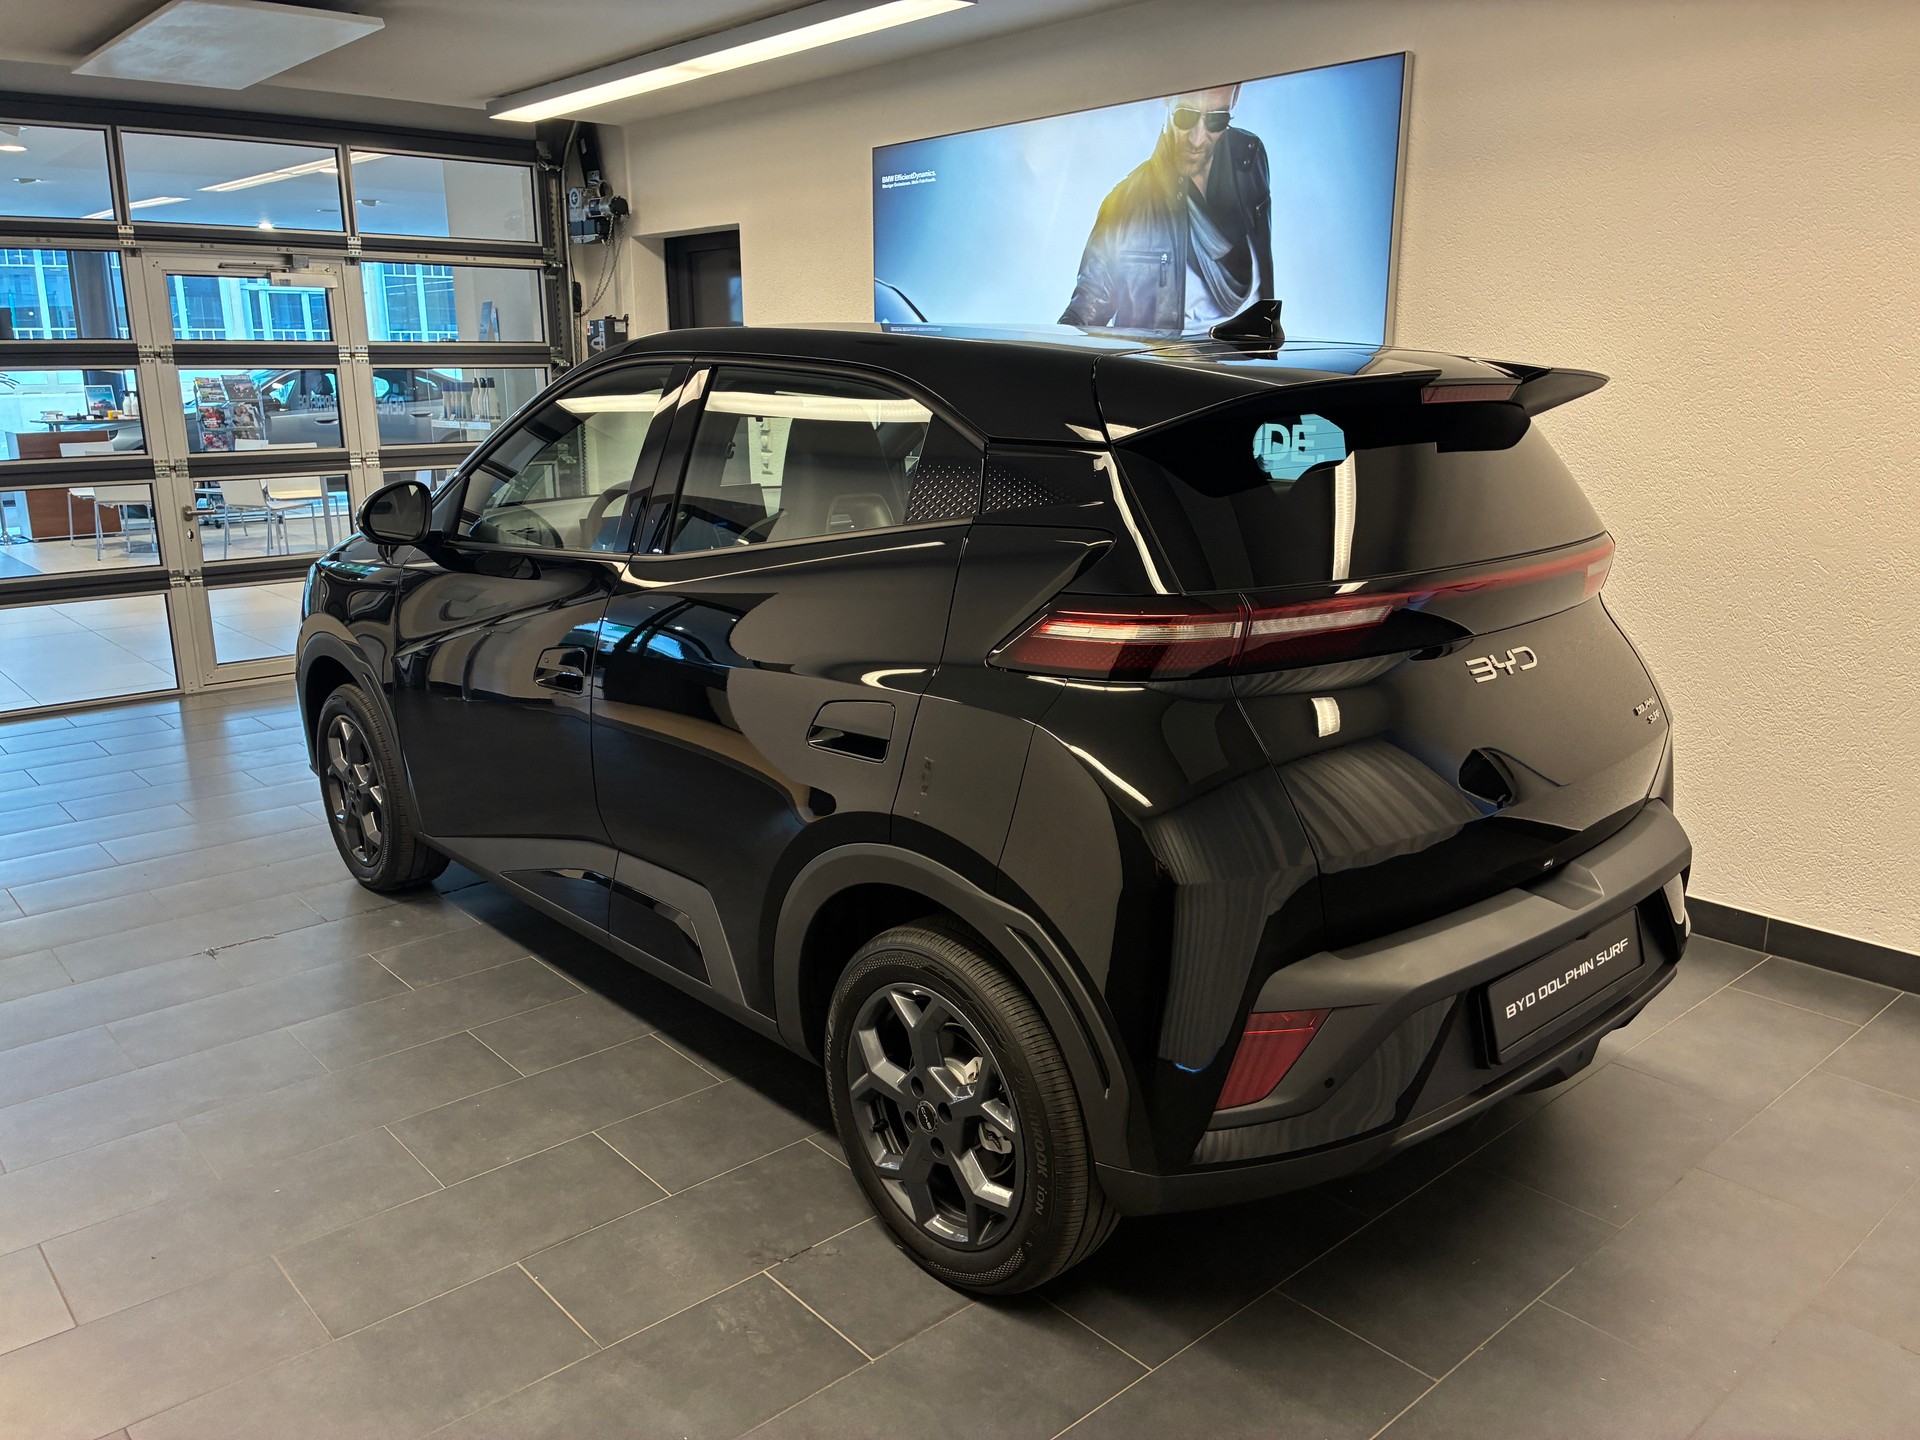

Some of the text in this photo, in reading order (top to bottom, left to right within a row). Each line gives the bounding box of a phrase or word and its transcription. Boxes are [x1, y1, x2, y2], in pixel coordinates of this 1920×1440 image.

[882, 175, 894, 183] BMW
[1466, 645, 1538, 683] BYD
[1505, 937, 1629, 1019] BYD DOLPHIN SURF
